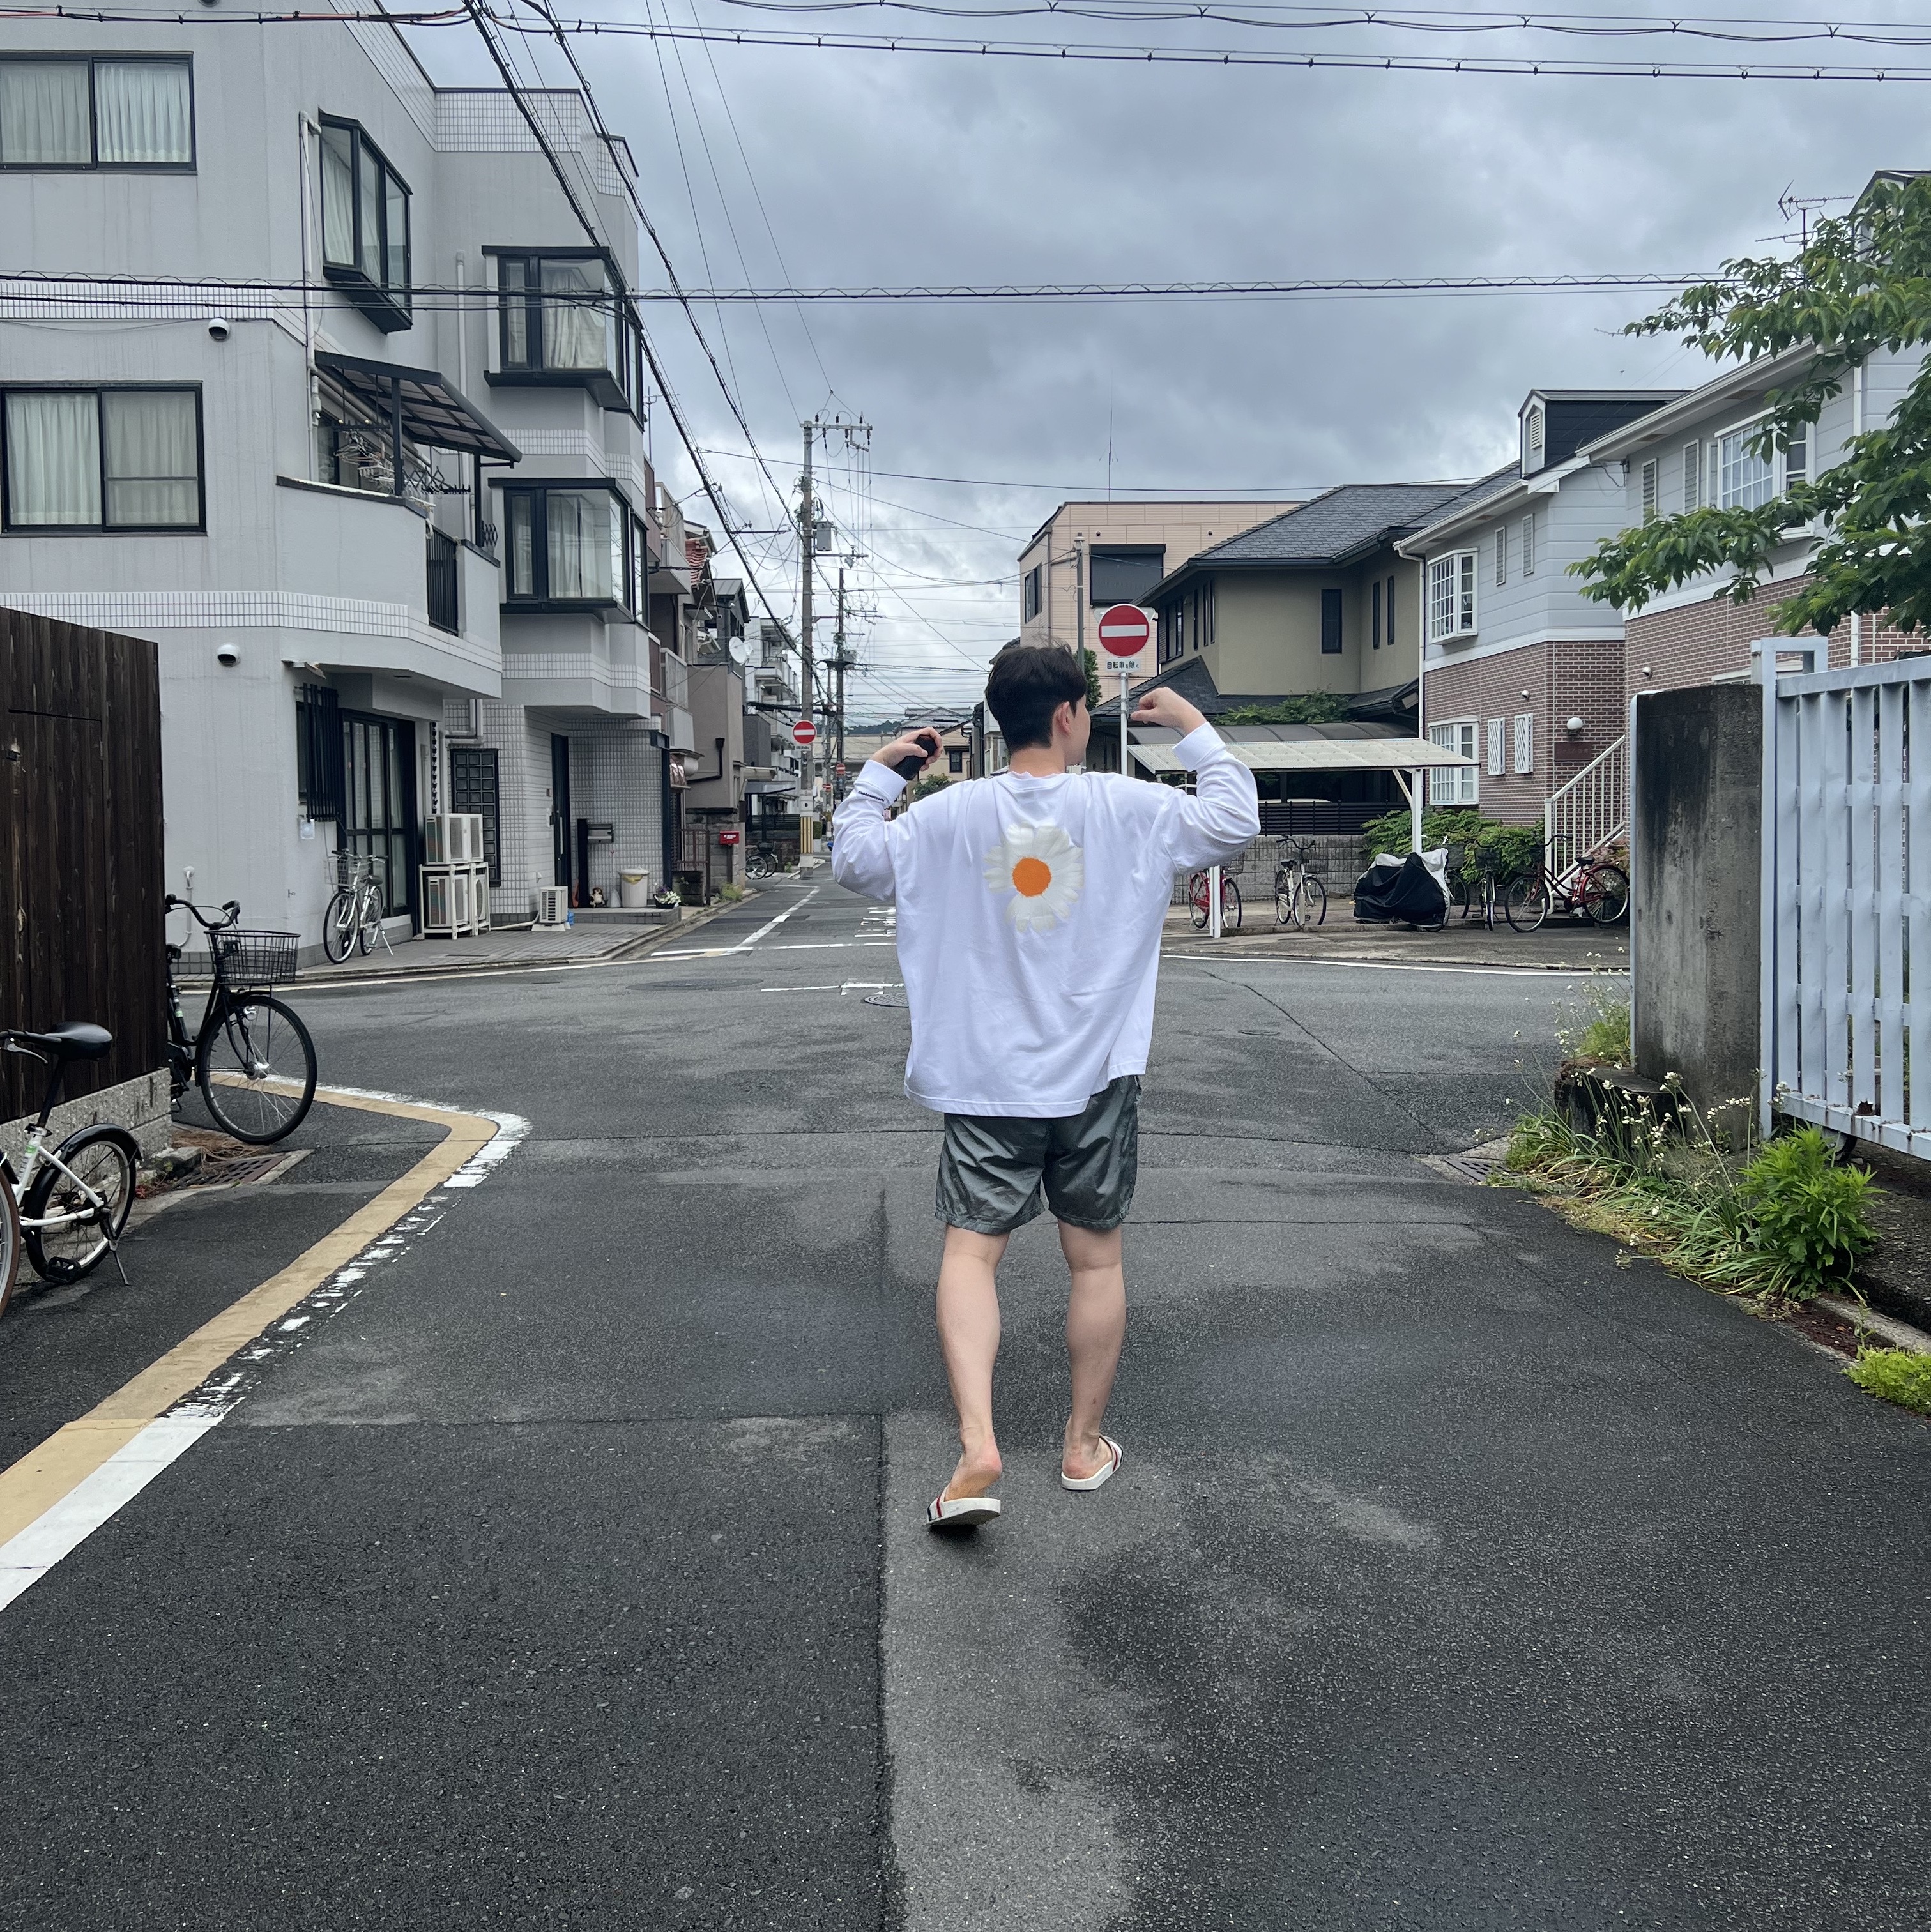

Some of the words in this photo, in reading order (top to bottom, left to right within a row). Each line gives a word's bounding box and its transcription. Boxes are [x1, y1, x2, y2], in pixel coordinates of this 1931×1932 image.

[1106, 660, 1140, 669] 自転車を除く
